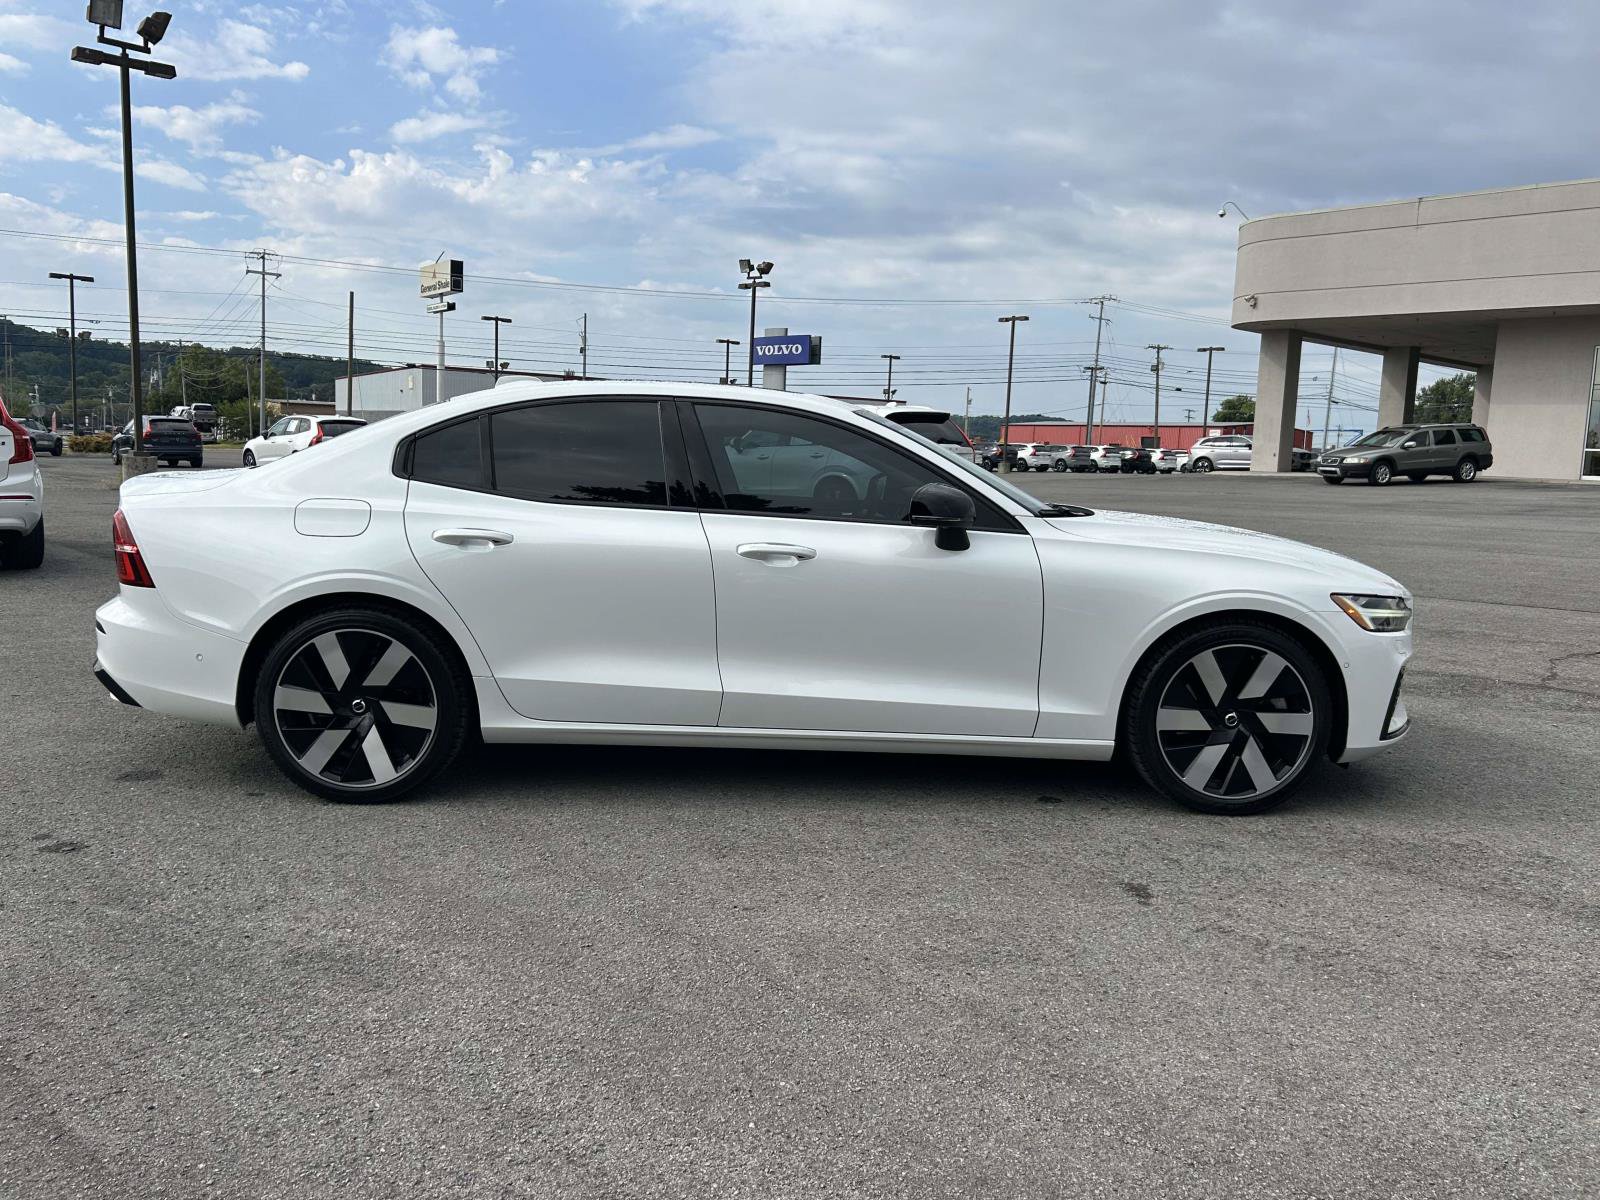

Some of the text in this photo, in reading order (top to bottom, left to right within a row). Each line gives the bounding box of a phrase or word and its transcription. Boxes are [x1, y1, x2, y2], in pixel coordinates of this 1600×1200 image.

[421, 279, 450, 293] General Shale
[756, 344, 802, 355] VOLVO
